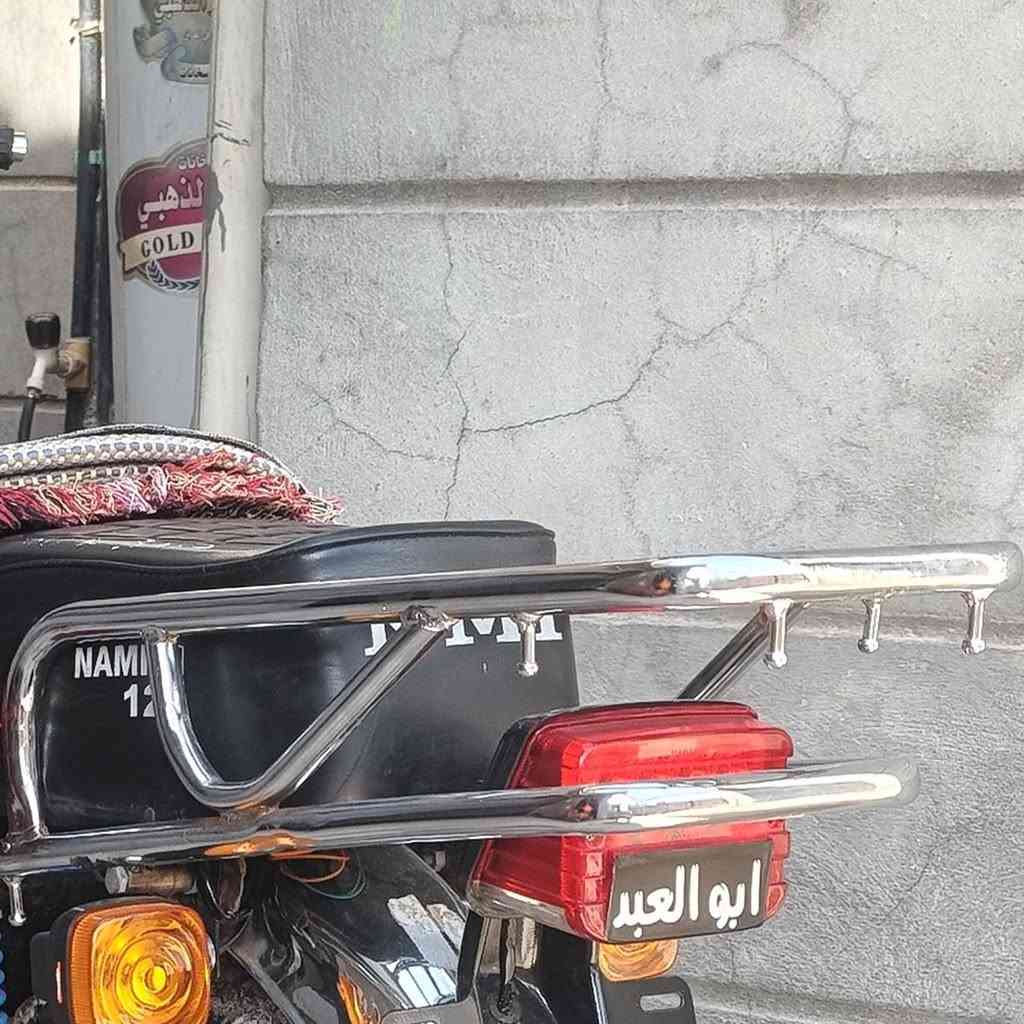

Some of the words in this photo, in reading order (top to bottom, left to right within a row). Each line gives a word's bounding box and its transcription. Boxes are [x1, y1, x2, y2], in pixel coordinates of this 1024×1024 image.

[137, 176, 204, 230] لذهبي
[142, 231, 195, 257] GOLD
[612, 863, 699, 938] العبد
[709, 858, 761, 929] ابو
